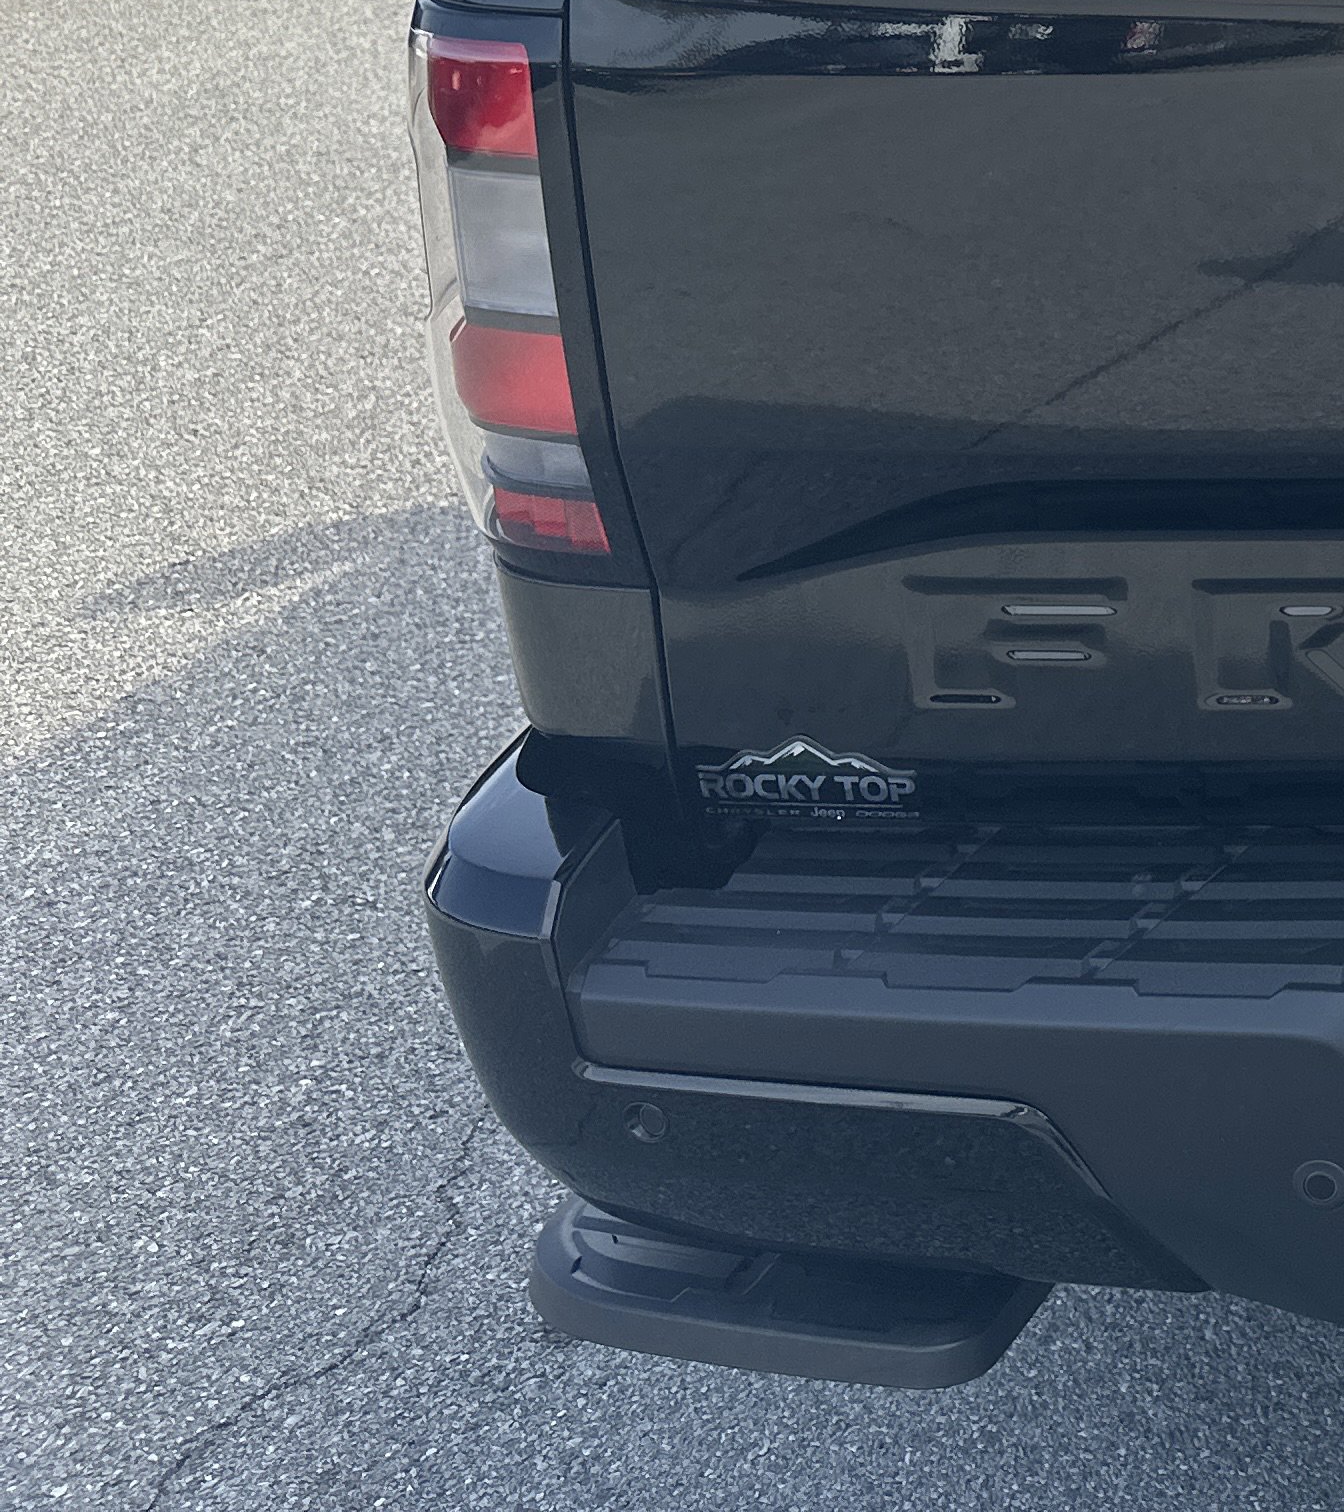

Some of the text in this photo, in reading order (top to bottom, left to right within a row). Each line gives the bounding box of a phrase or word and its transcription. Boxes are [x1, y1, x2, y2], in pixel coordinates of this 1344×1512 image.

[697, 773, 916, 803] ROCKY TOP
[810, 806, 846, 819] Jeep
